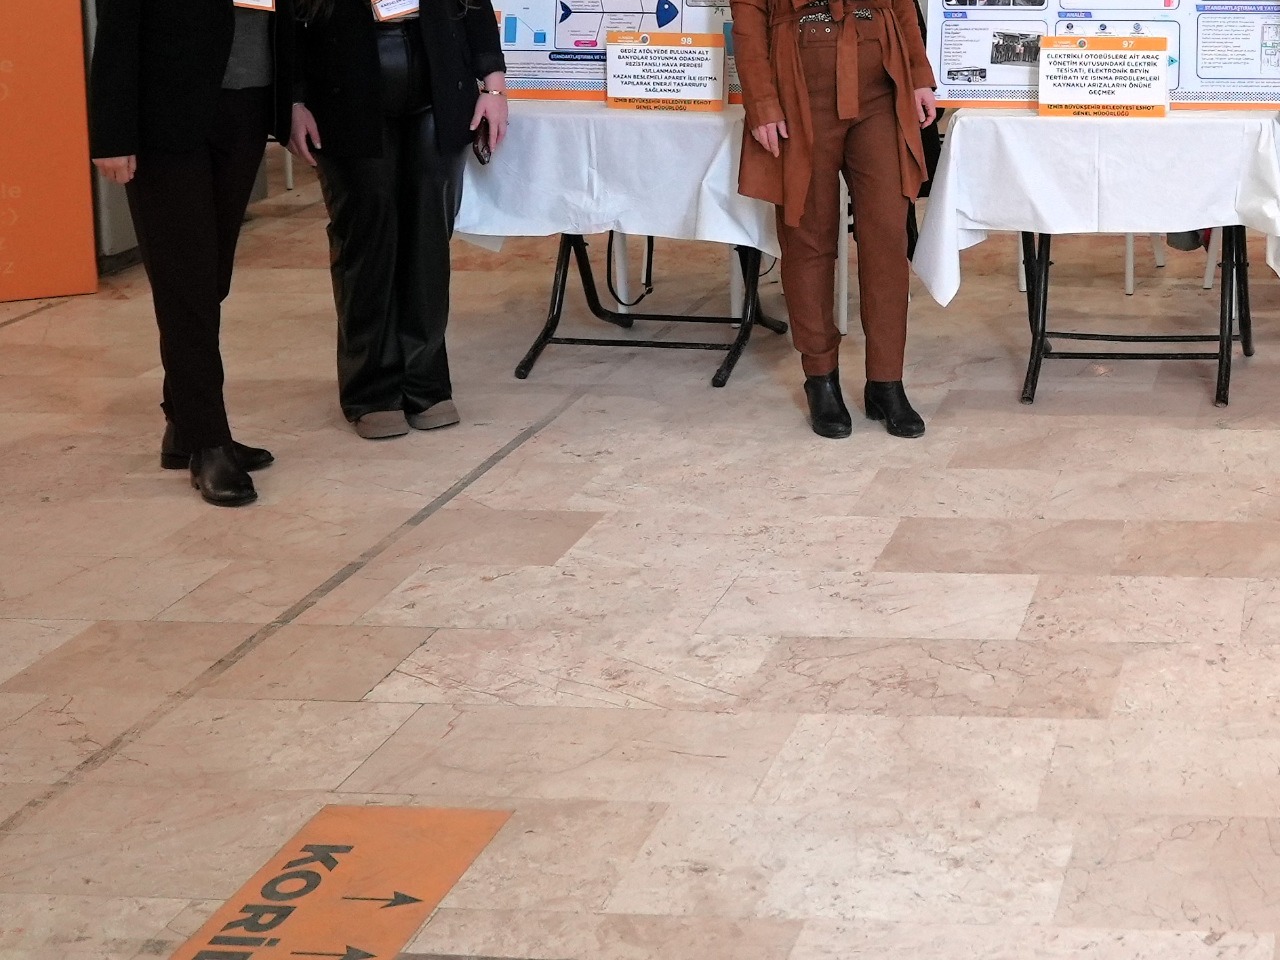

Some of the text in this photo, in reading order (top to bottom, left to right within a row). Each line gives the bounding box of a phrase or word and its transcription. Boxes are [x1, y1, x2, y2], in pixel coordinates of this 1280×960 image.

[681, 37, 692, 45] 98
[1122, 40, 1134, 48] 97
[1128, 81, 1152, 89] ÖNÜNE
